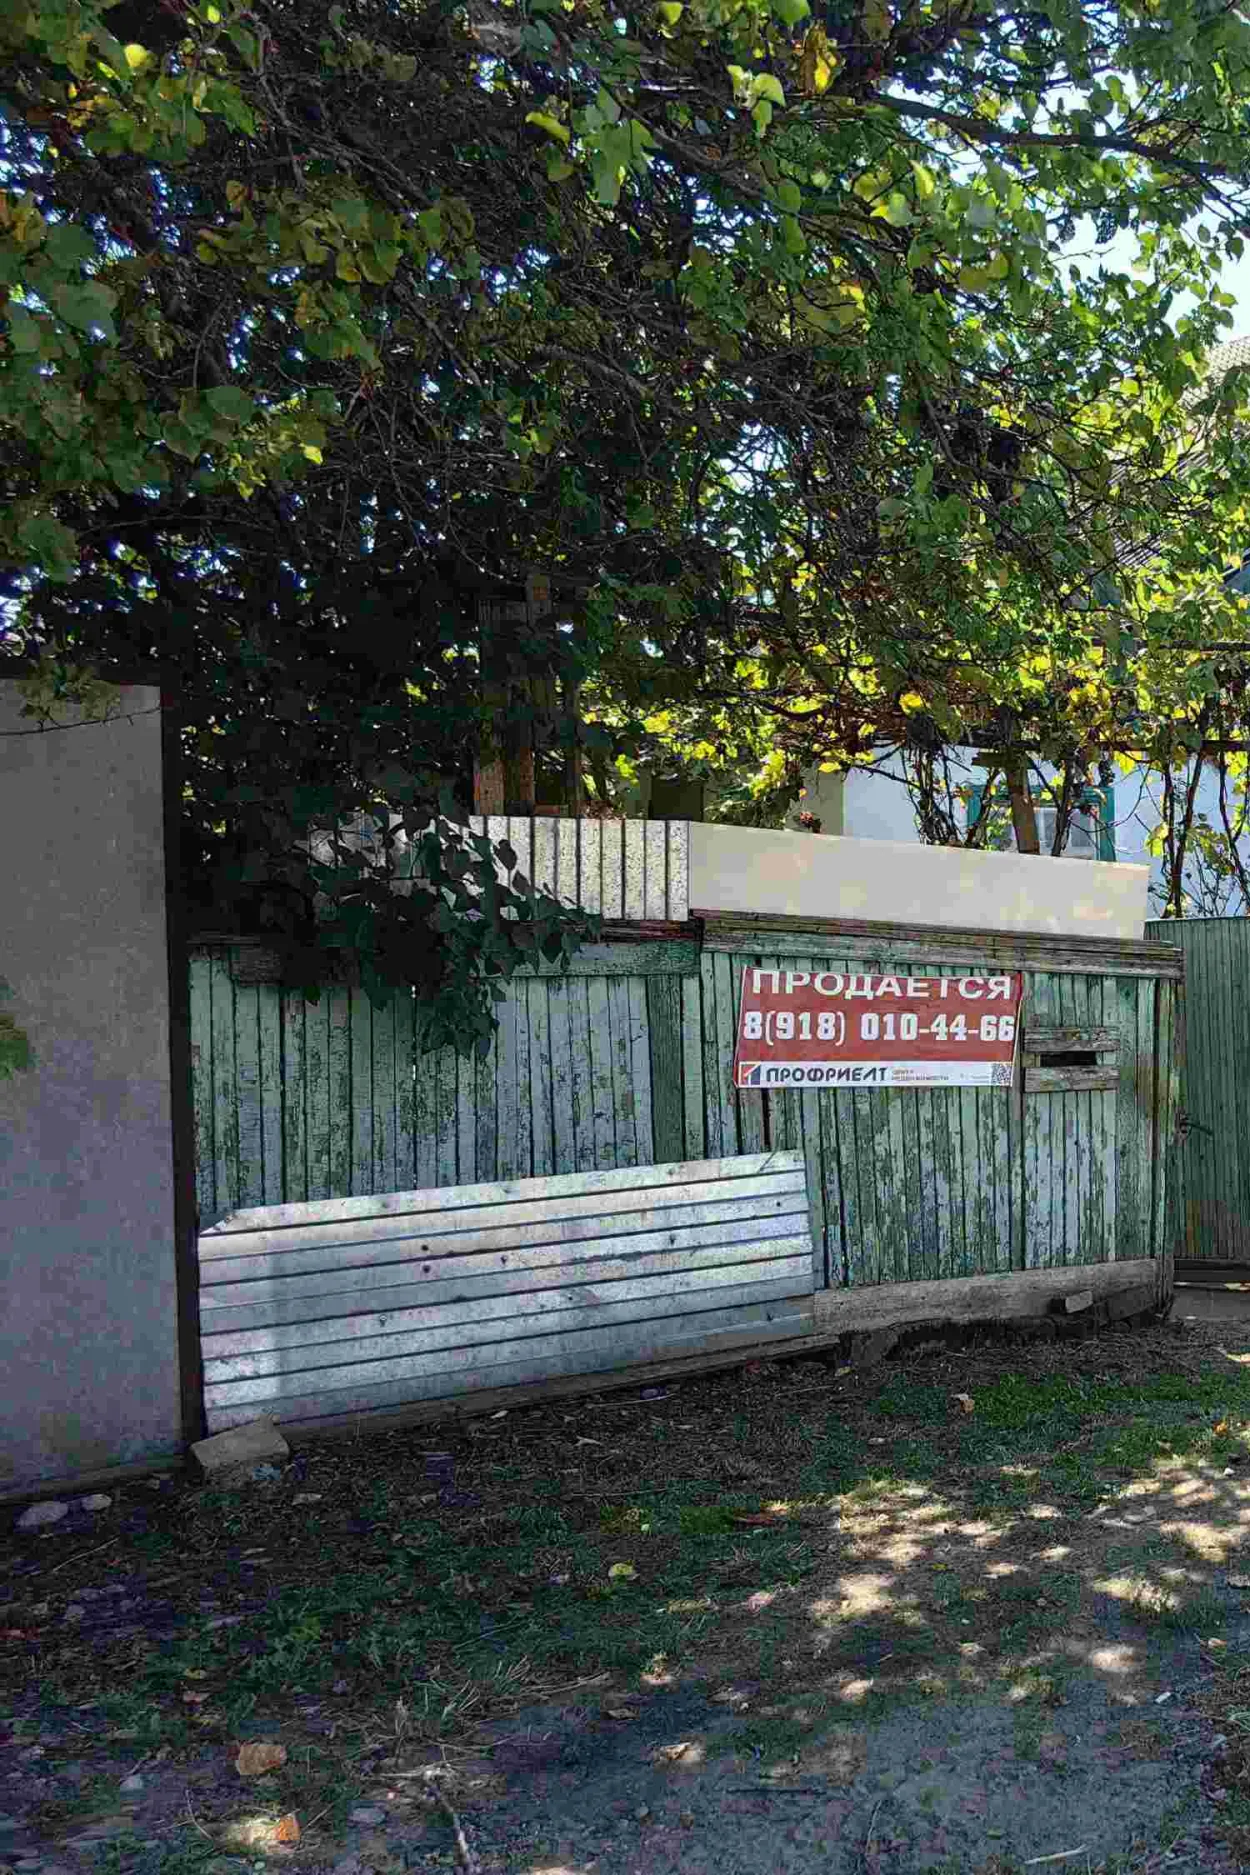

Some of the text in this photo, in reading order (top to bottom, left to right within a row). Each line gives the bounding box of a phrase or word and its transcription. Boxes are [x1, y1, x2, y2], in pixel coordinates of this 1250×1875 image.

[751, 969, 1012, 1000] ПРОДАЕТСЯ
[743, 1010, 1016, 1046] 8(918) 010-44-66
[766, 1066, 889, 1083] ПРОФРИЕЛТ
